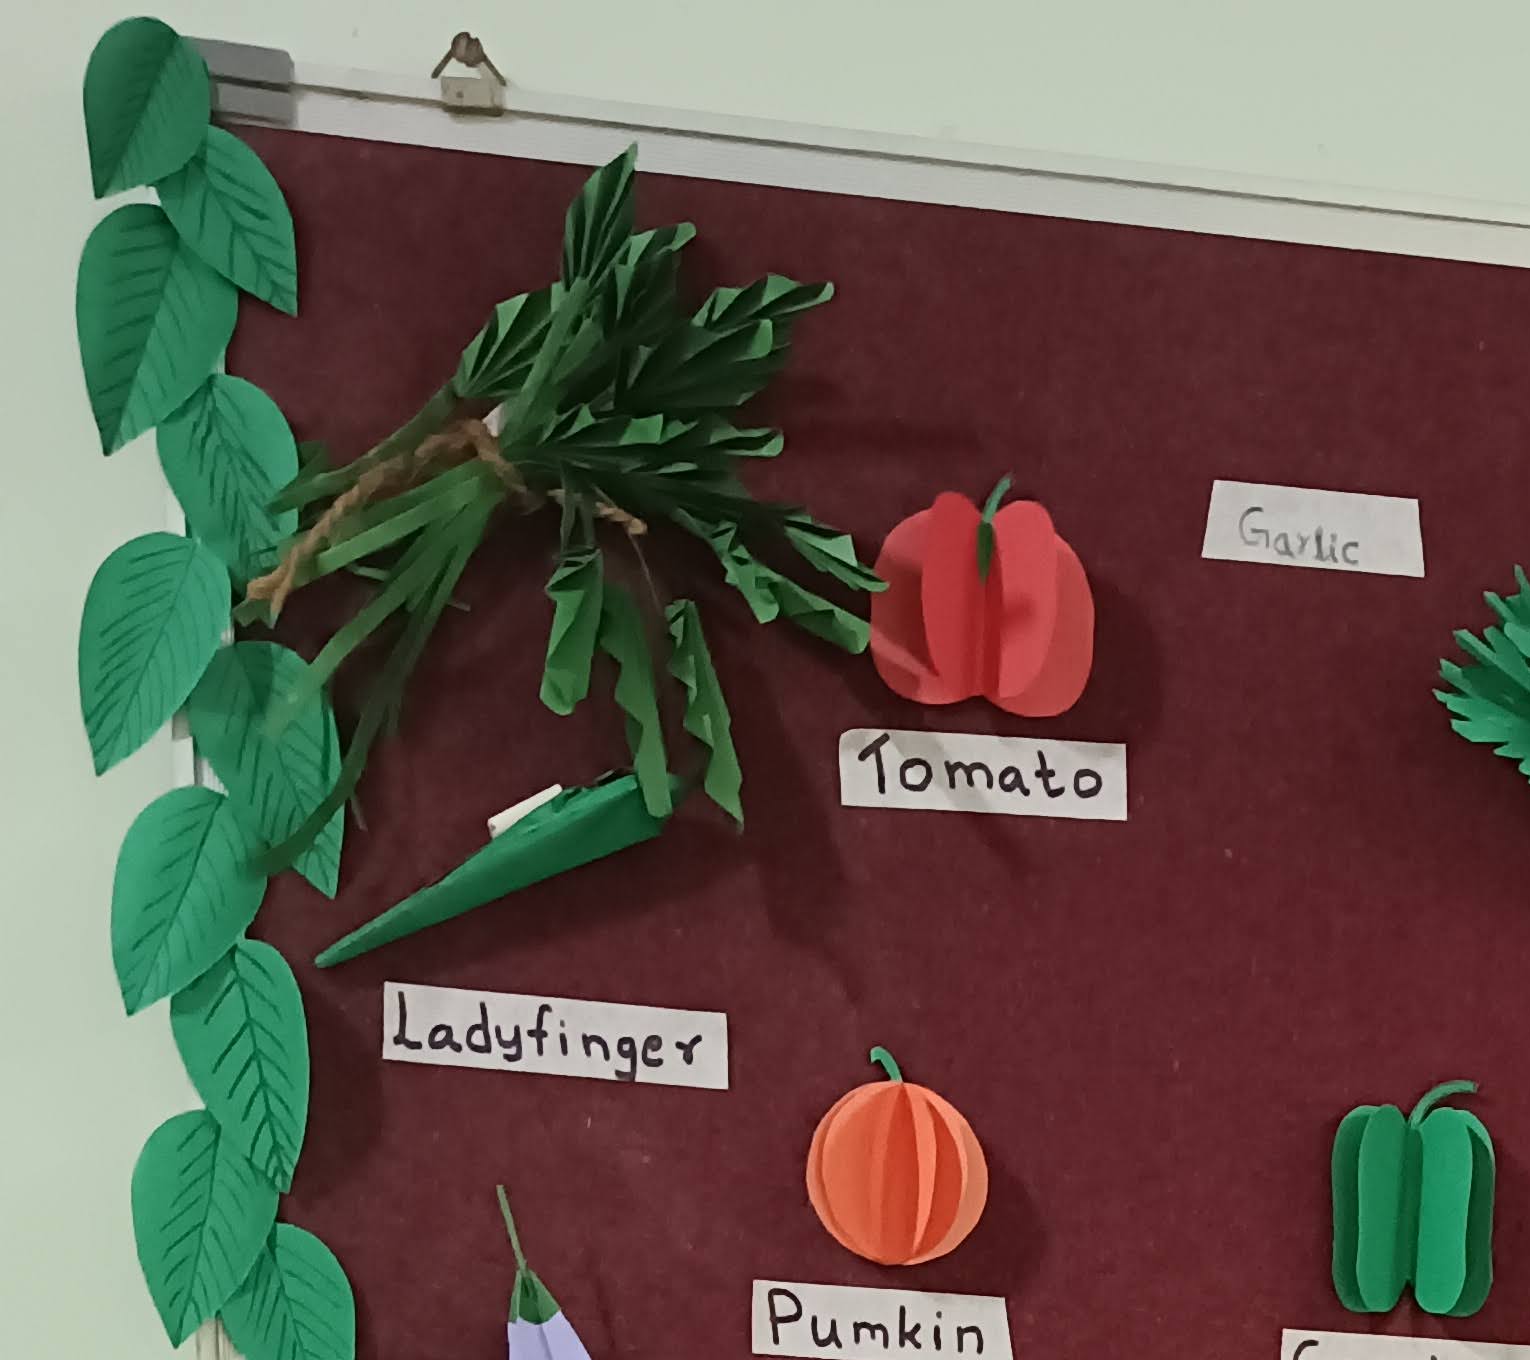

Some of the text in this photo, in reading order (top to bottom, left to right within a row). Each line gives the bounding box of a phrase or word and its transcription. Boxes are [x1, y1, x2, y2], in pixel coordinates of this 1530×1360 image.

[1238, 505, 1360, 566] Garlic
[857, 732, 1105, 800] Tomato
[391, 991, 704, 1083] Ladyfinger
[766, 1288, 986, 1356] Pumkin
